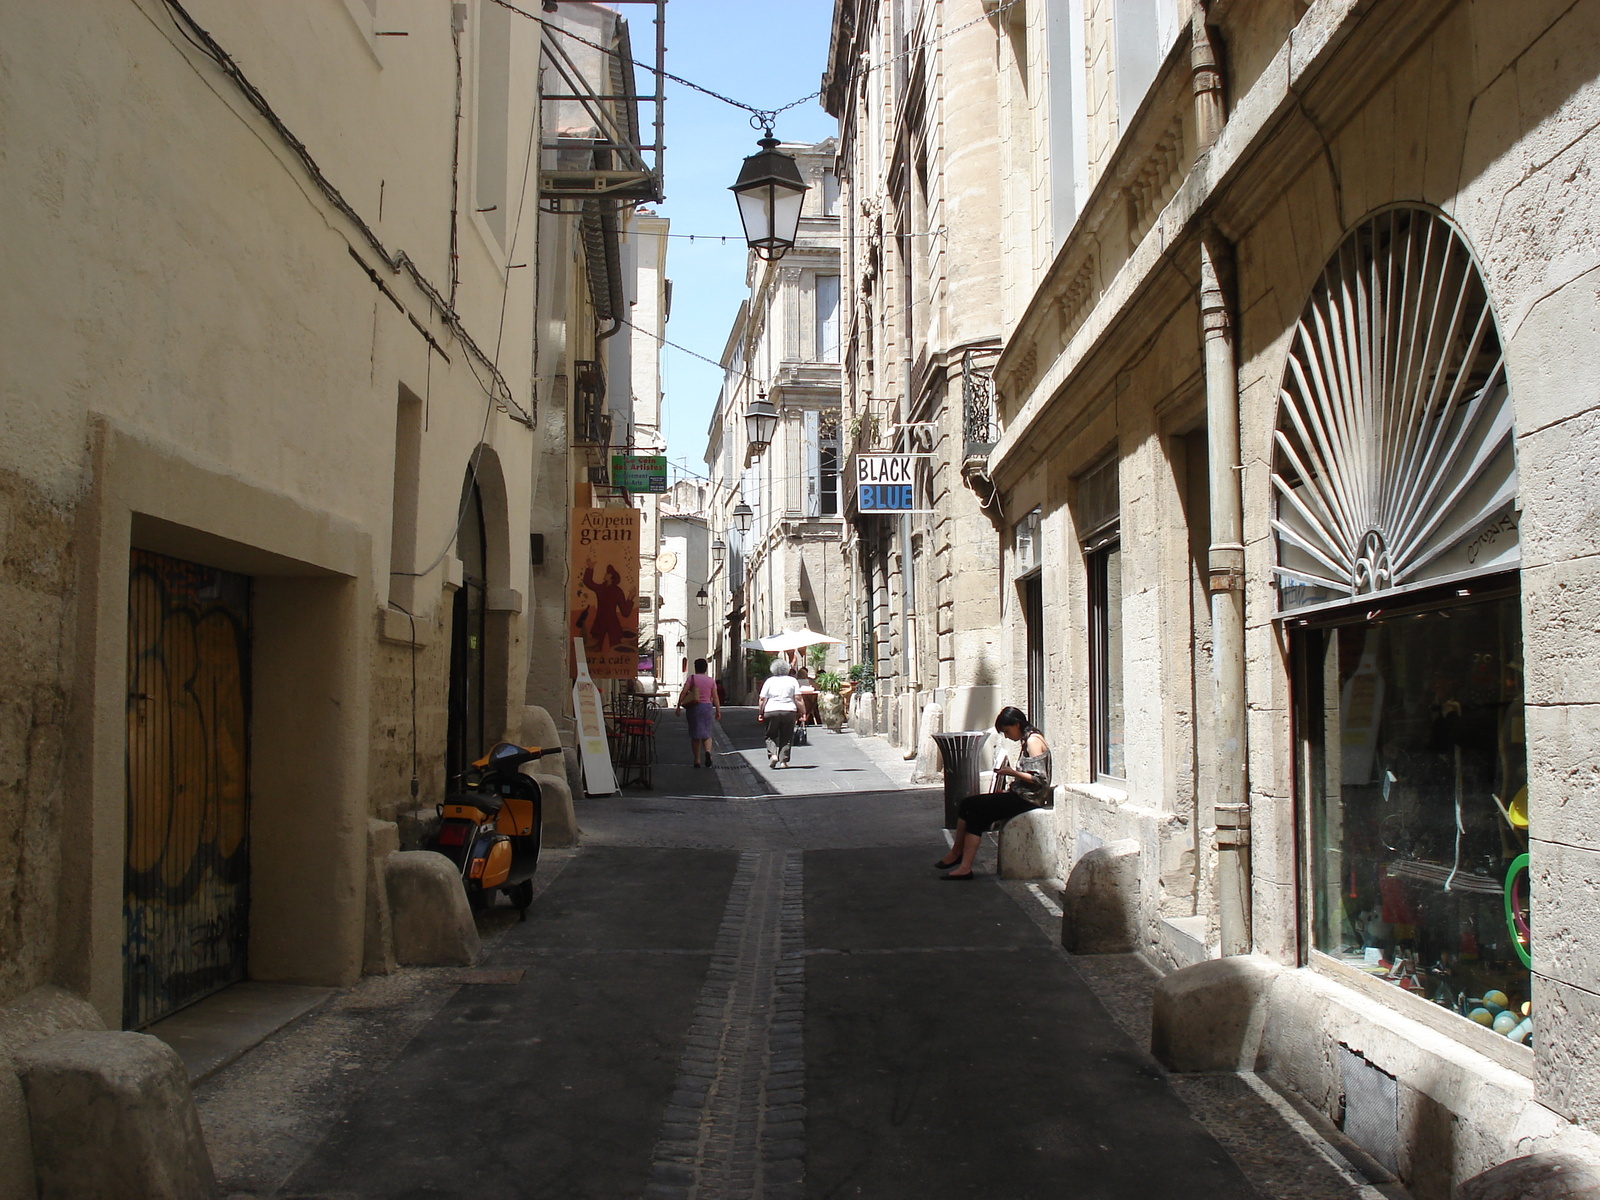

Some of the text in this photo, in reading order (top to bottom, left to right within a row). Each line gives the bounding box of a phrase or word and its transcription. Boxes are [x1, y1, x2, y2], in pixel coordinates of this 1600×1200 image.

[859, 457, 911, 482] BLACK
[860, 485, 912, 509] BLUE
[581, 513, 633, 528] Au petit
[580, 526, 632, 546] grain
